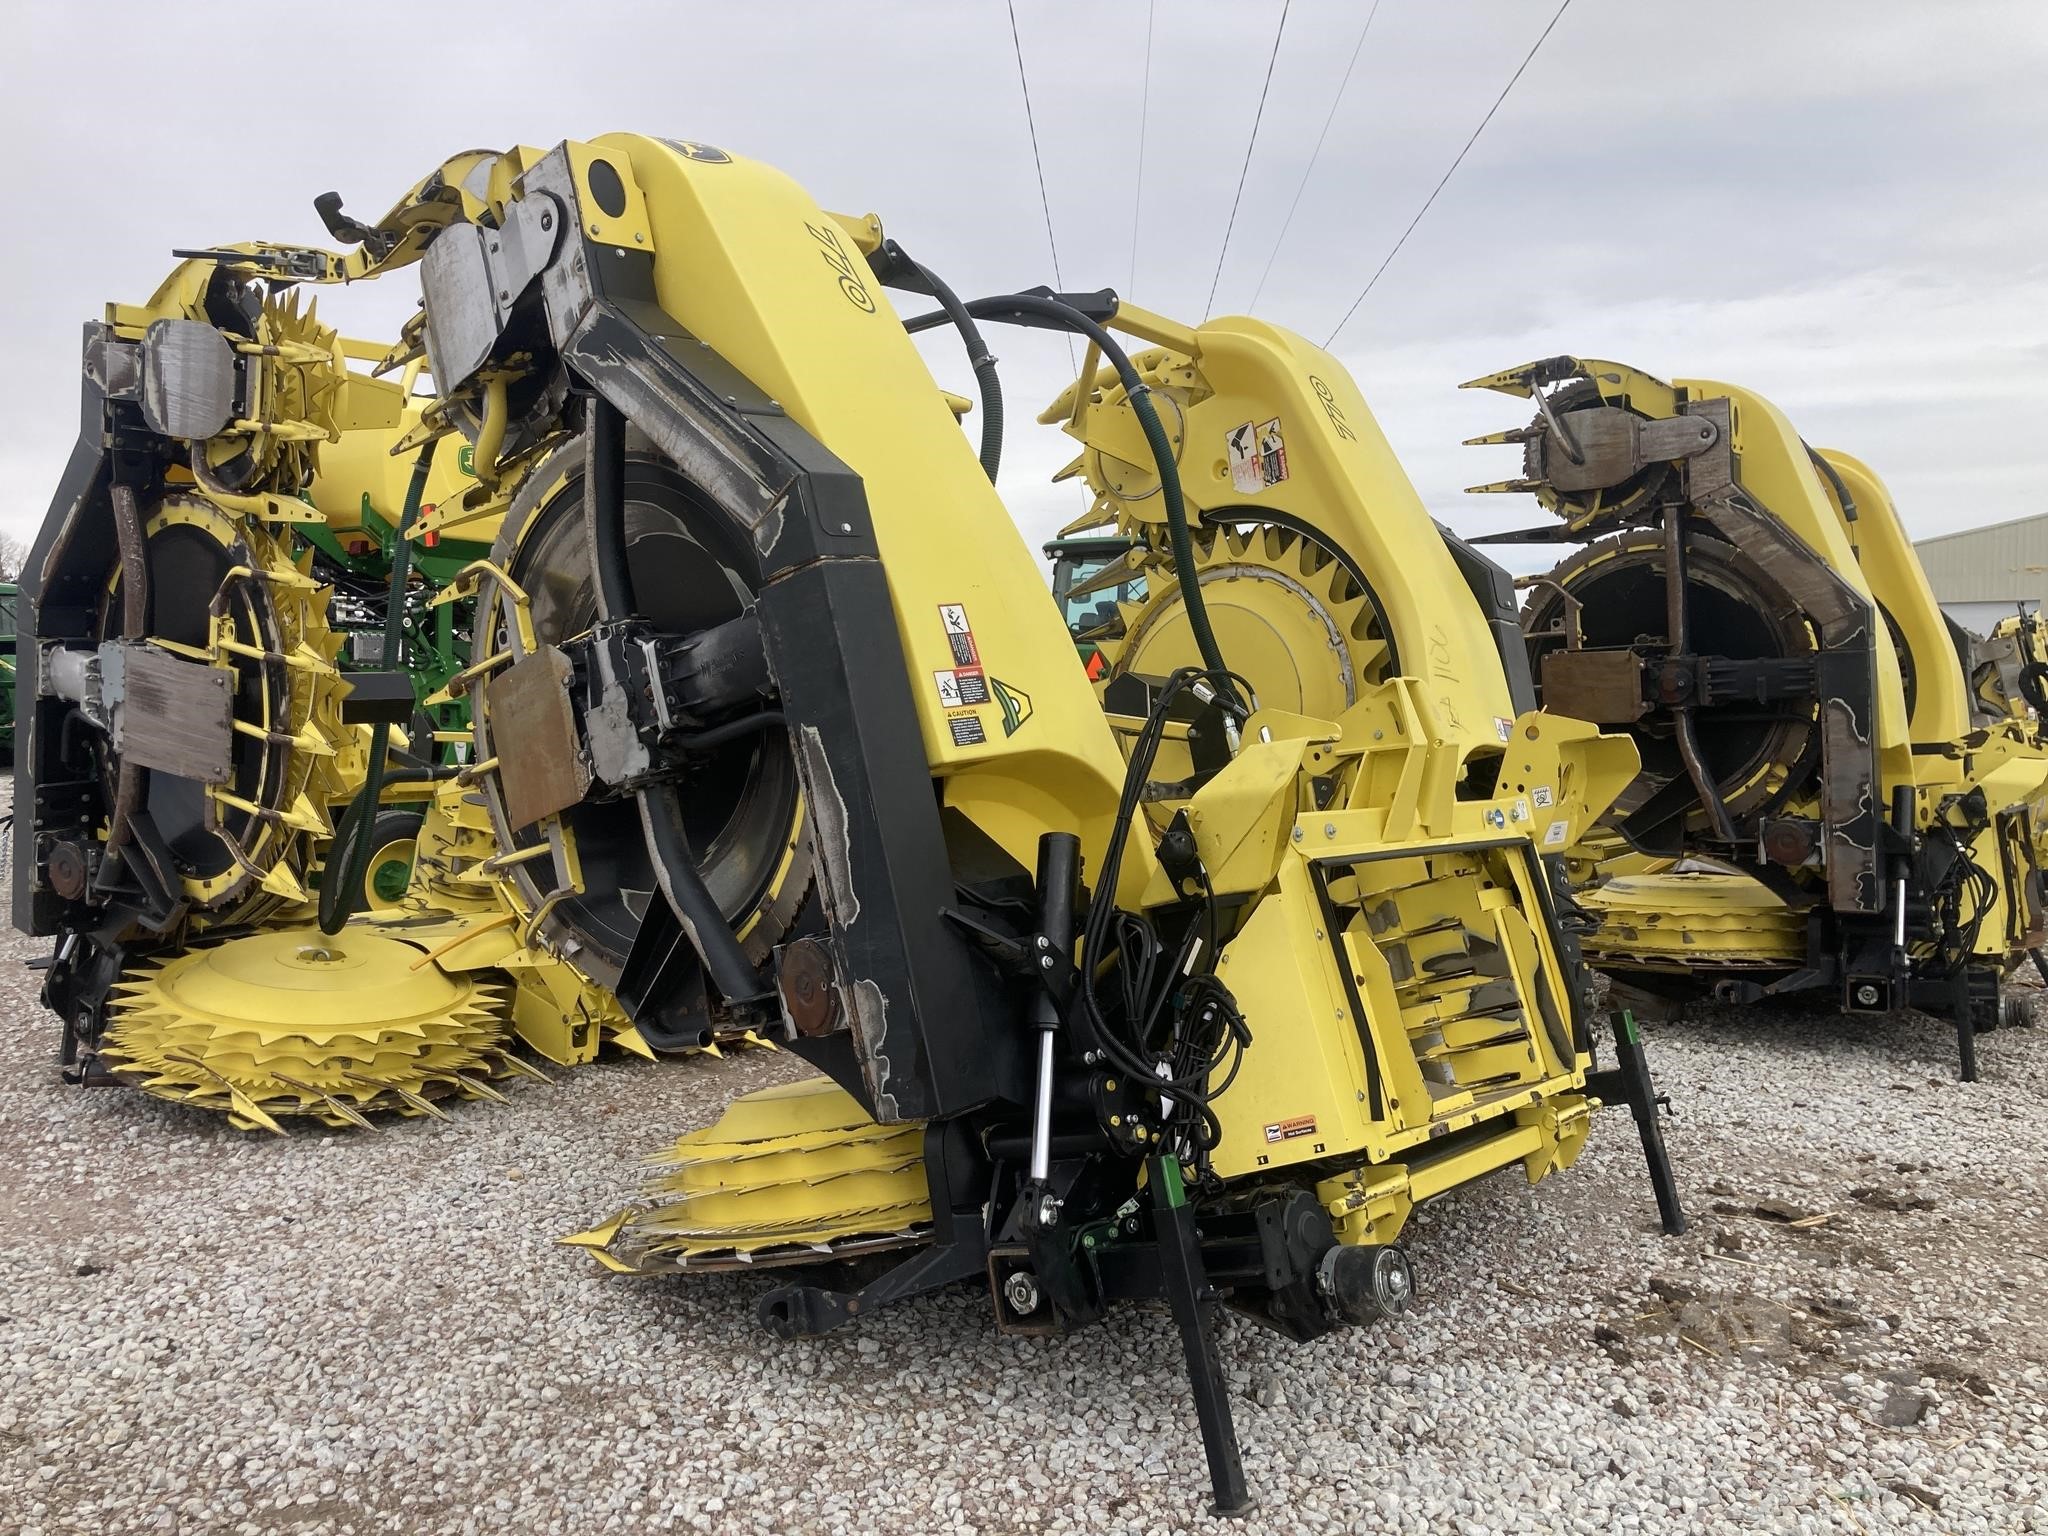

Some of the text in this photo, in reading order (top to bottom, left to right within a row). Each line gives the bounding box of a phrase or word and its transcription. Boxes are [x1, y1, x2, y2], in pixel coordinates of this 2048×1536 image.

[803, 221, 876, 314] 770
[1309, 375, 1358, 442] 770
[952, 709, 977, 717] CAUTION
[1287, 1118, 1314, 1128] WARNING
